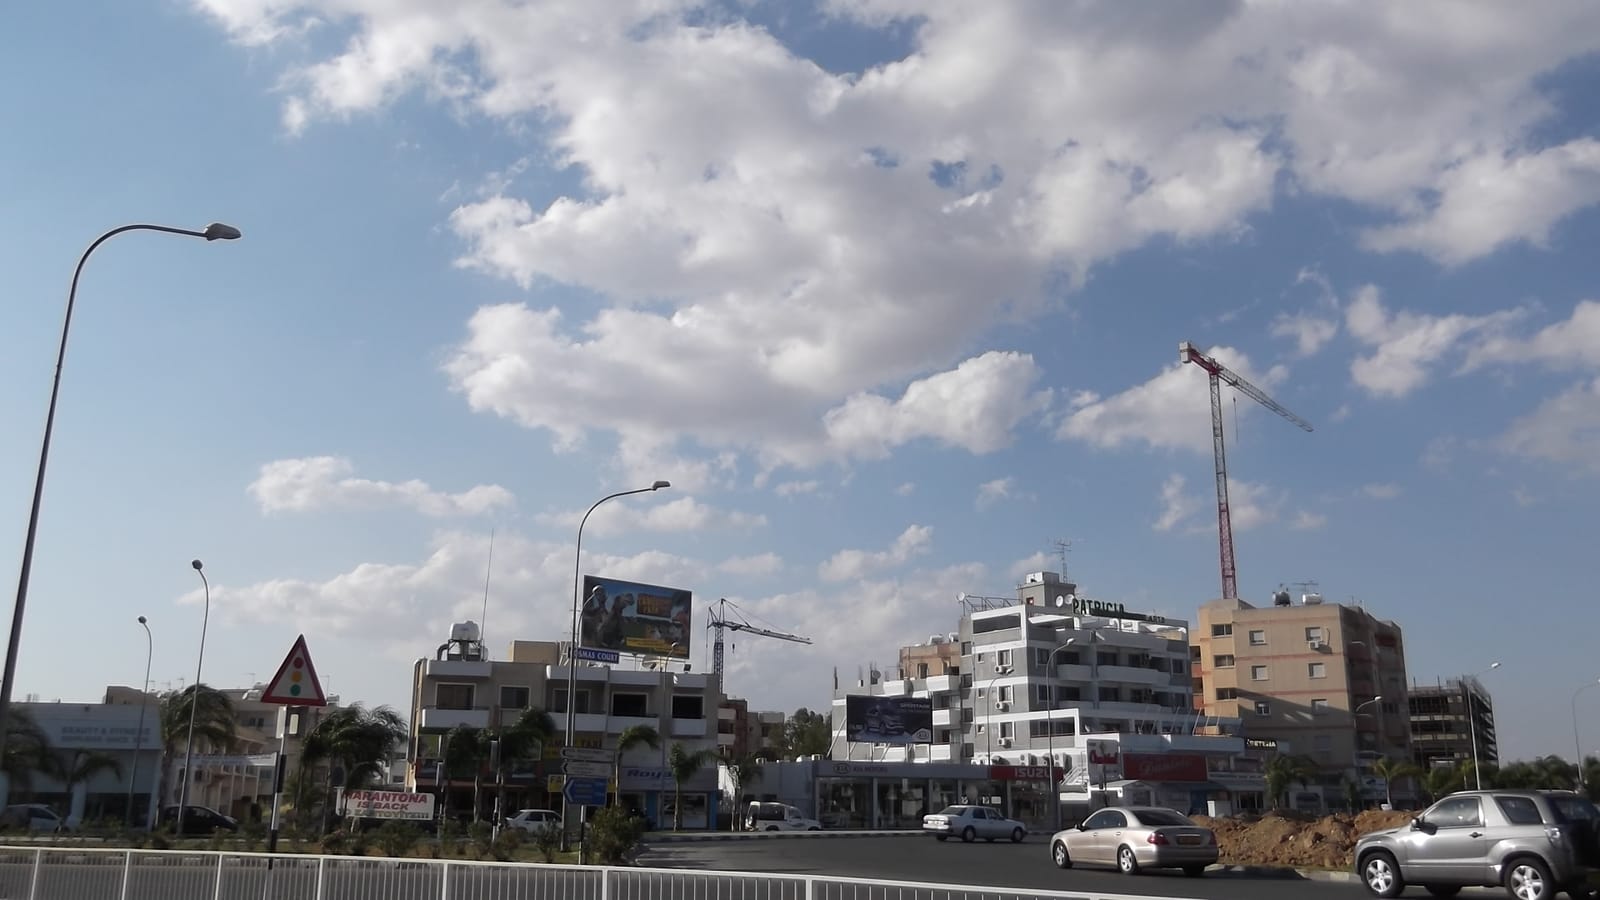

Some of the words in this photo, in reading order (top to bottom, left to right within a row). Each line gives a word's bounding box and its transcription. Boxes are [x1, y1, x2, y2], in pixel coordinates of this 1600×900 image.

[1072, 598, 1125, 615] PATRICIA
[597, 652, 618, 662] COURT
[627, 769, 673, 779] Roya
[357, 801, 369, 809] IS
[373, 802, 409, 810] BACK
